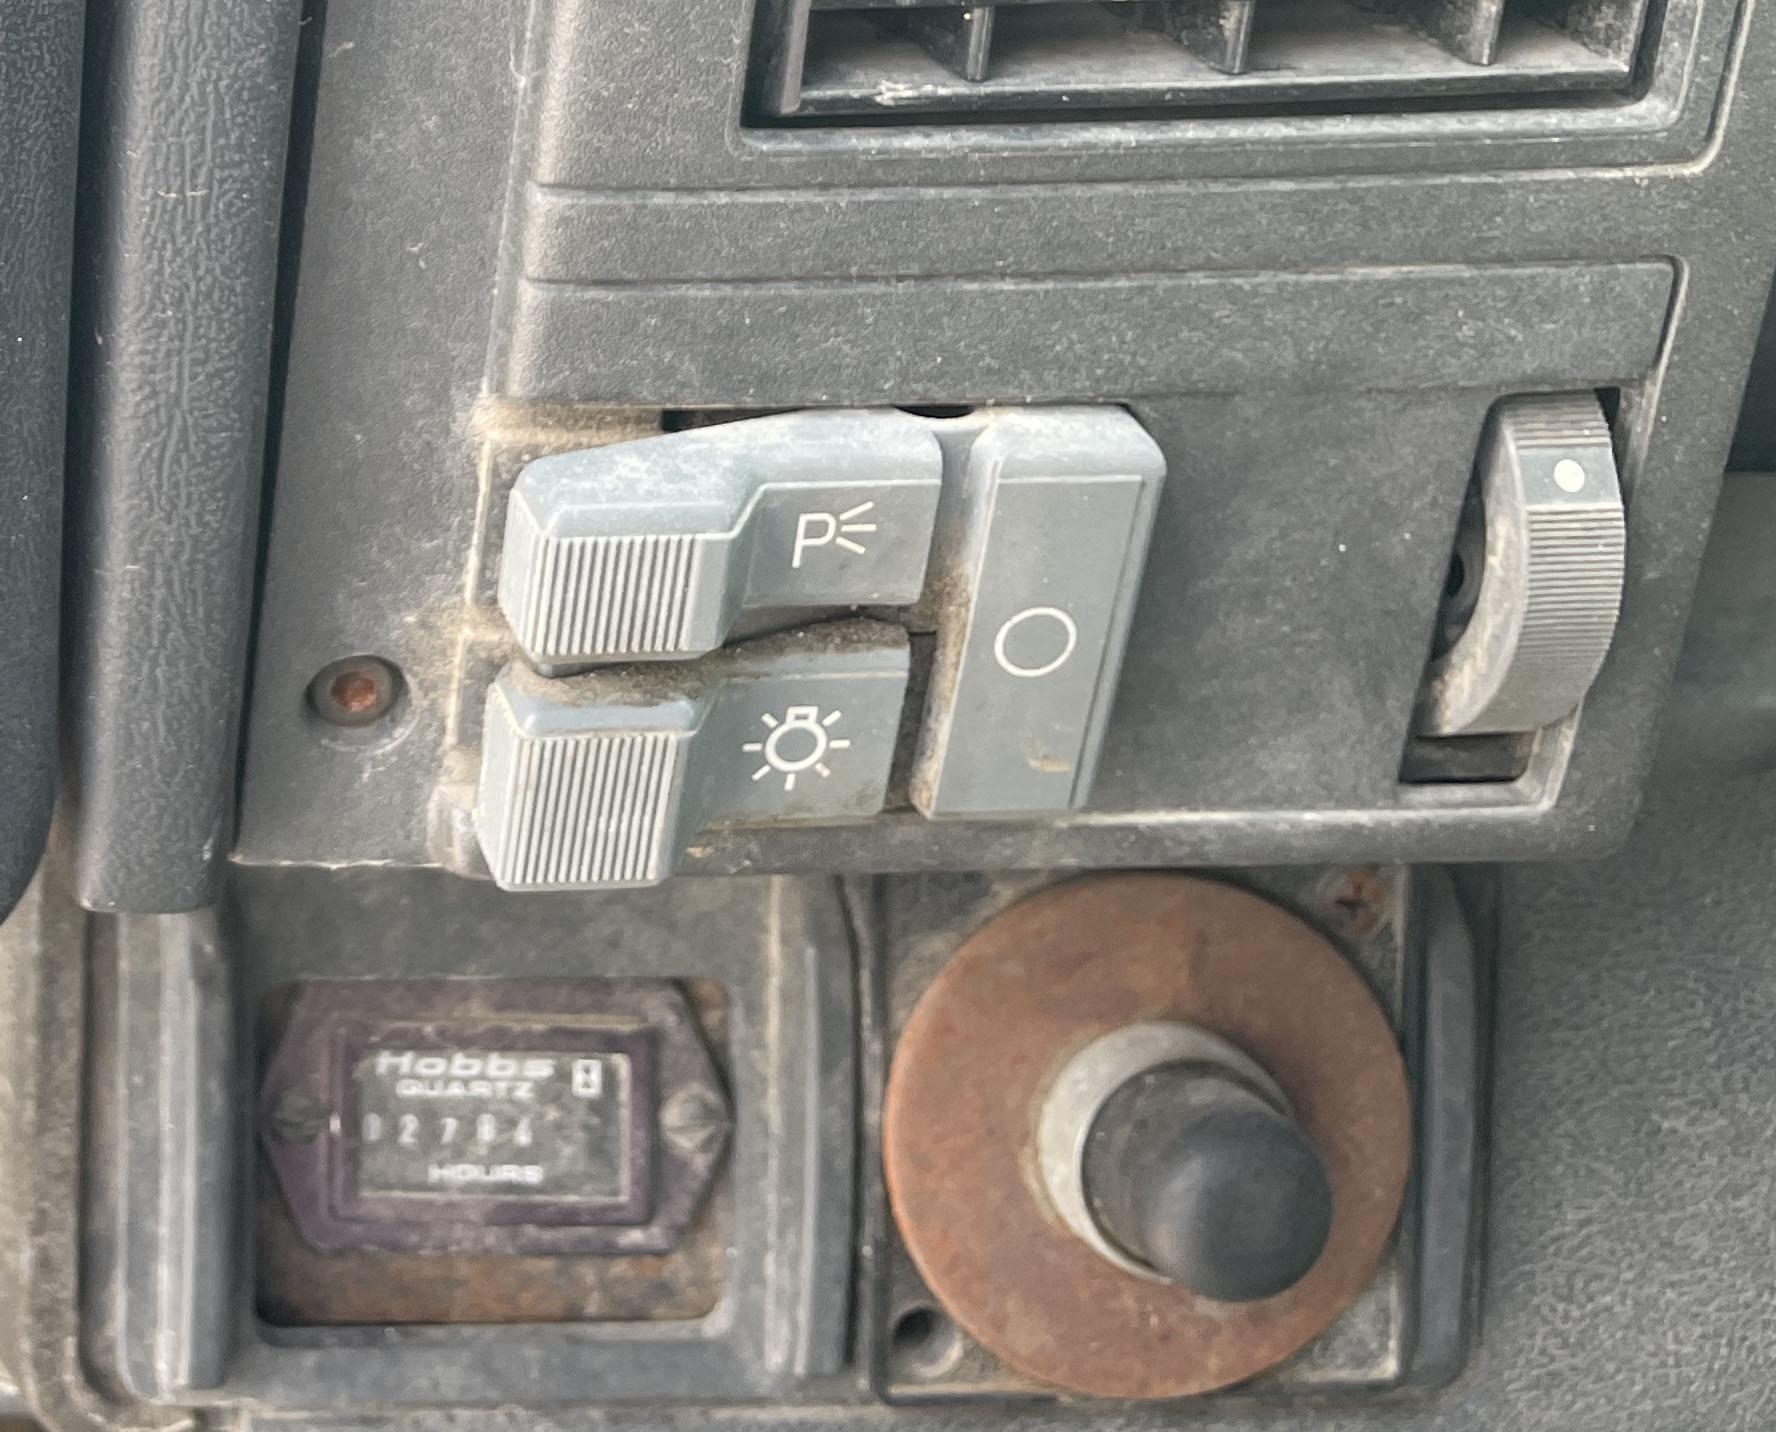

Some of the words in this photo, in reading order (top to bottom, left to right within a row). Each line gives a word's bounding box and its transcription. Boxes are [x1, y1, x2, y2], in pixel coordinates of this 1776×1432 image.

[374, 1050, 556, 1079] Hobbs
[395, 1079, 536, 1099] QUARTZ
[426, 1163, 545, 1185] HOURS
